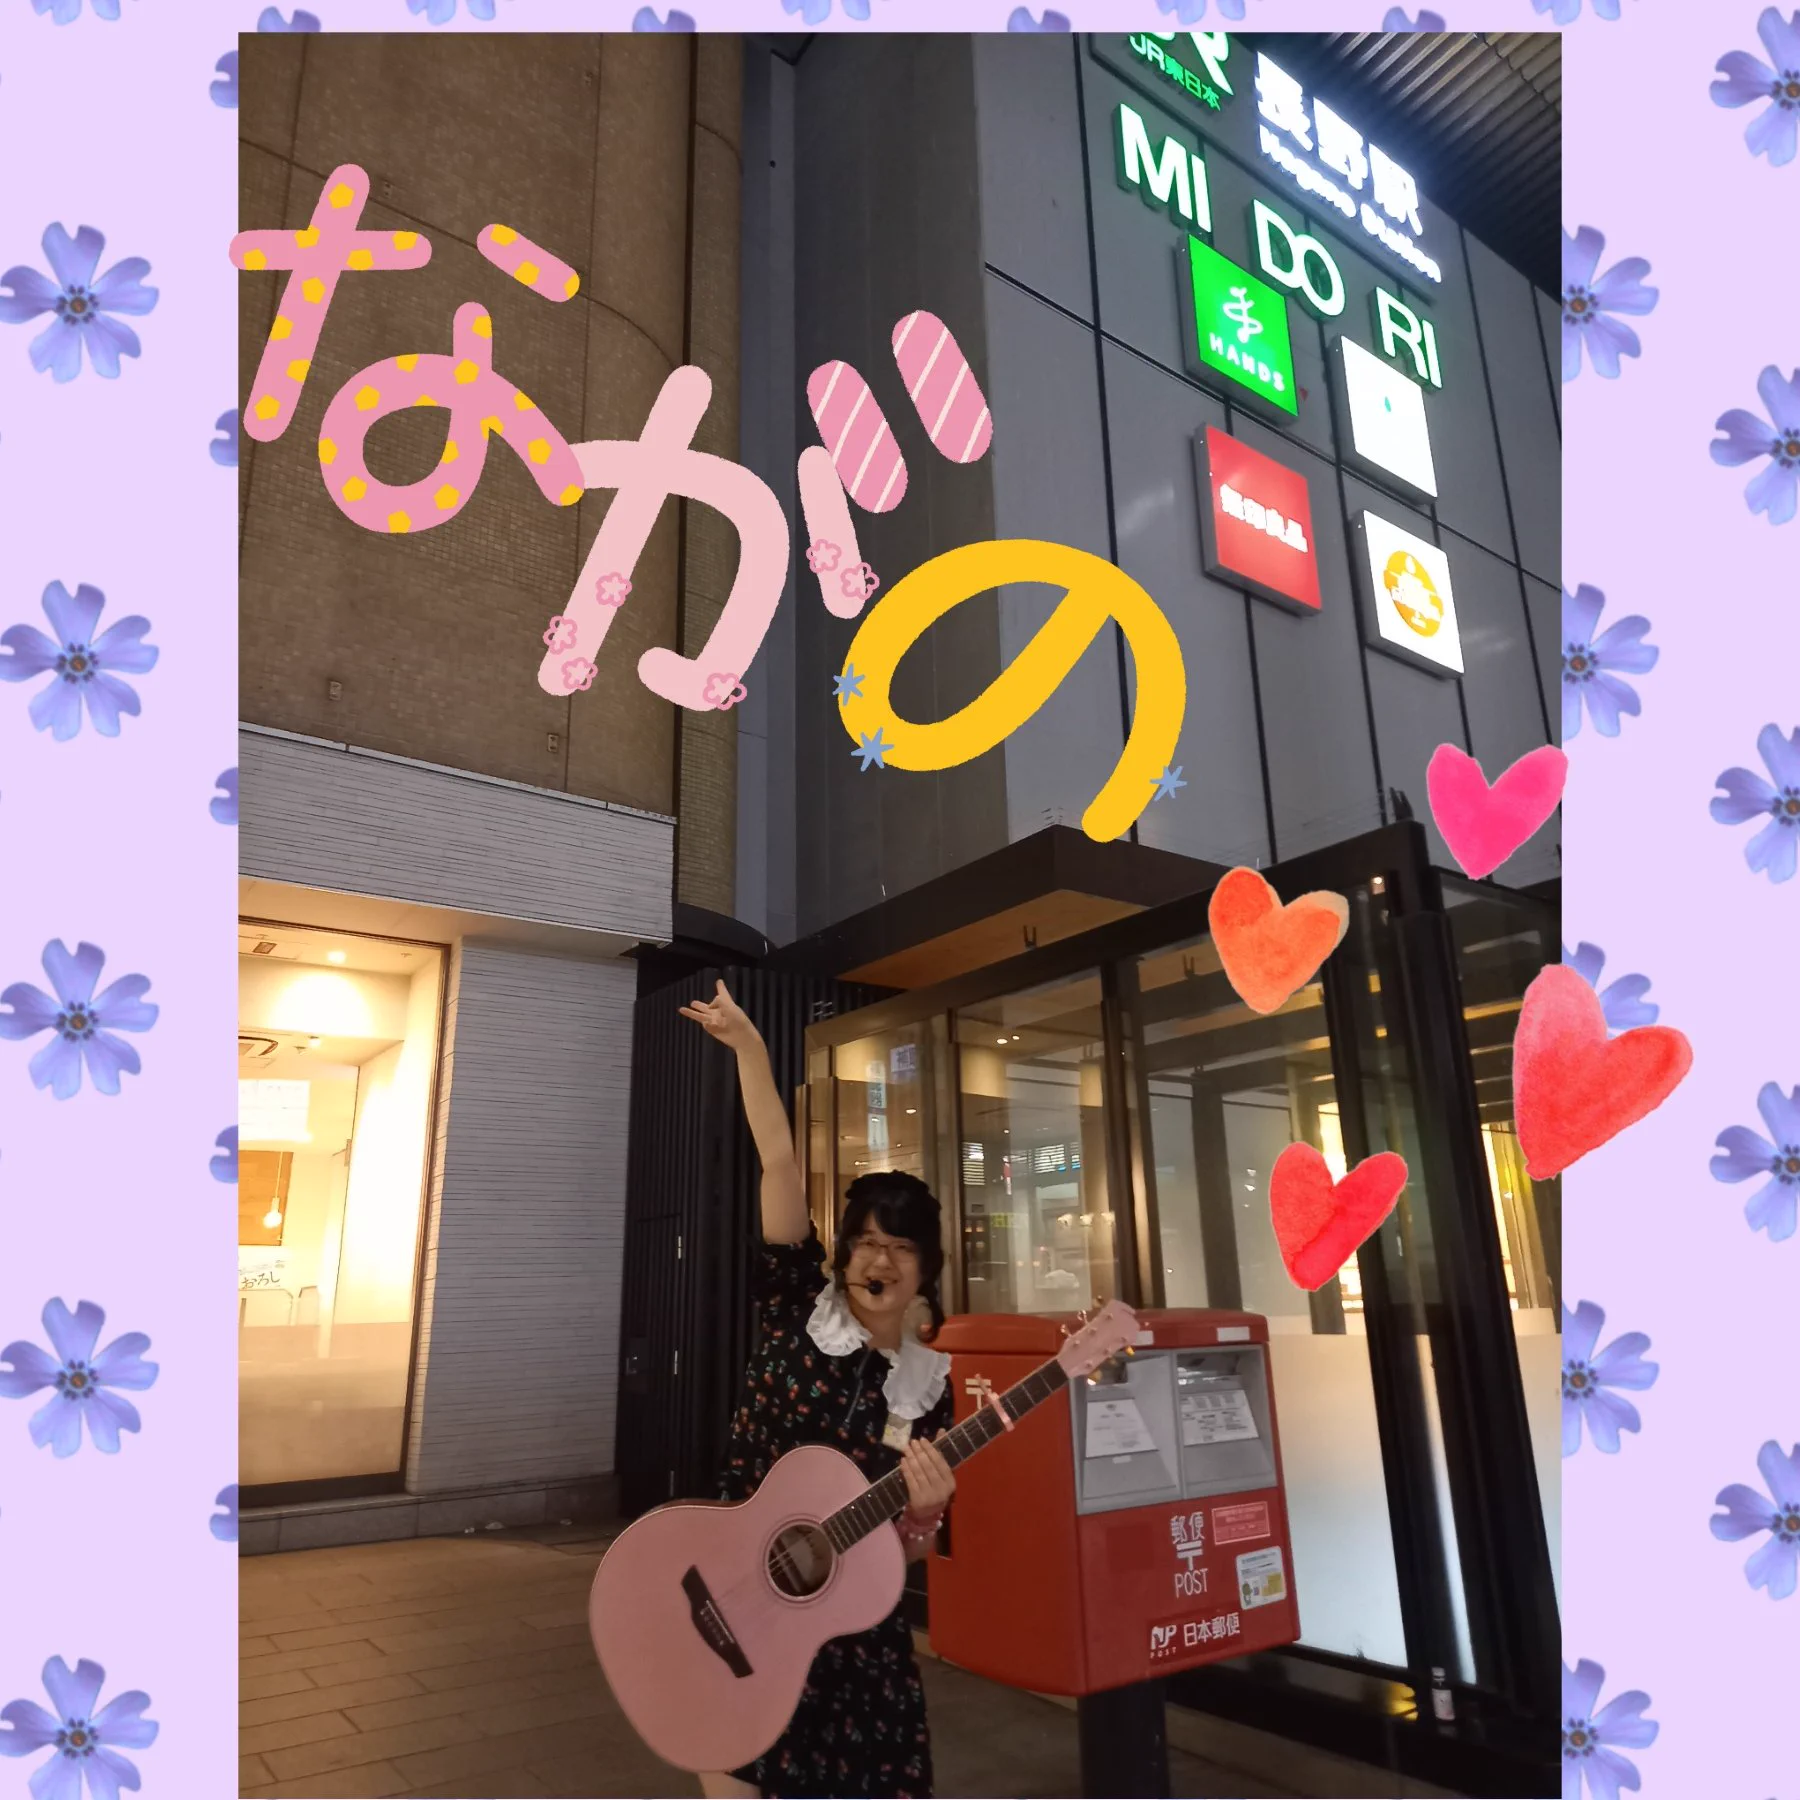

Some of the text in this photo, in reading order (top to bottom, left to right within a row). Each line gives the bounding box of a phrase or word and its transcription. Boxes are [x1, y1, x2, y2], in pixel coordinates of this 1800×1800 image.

[1209, 331, 1285, 392] HANDS
[1170, 1511, 1205, 1544] 郵便
[1174, 1568, 1208, 1599] POST
[1183, 1612, 1240, 1646] 日本郵便
